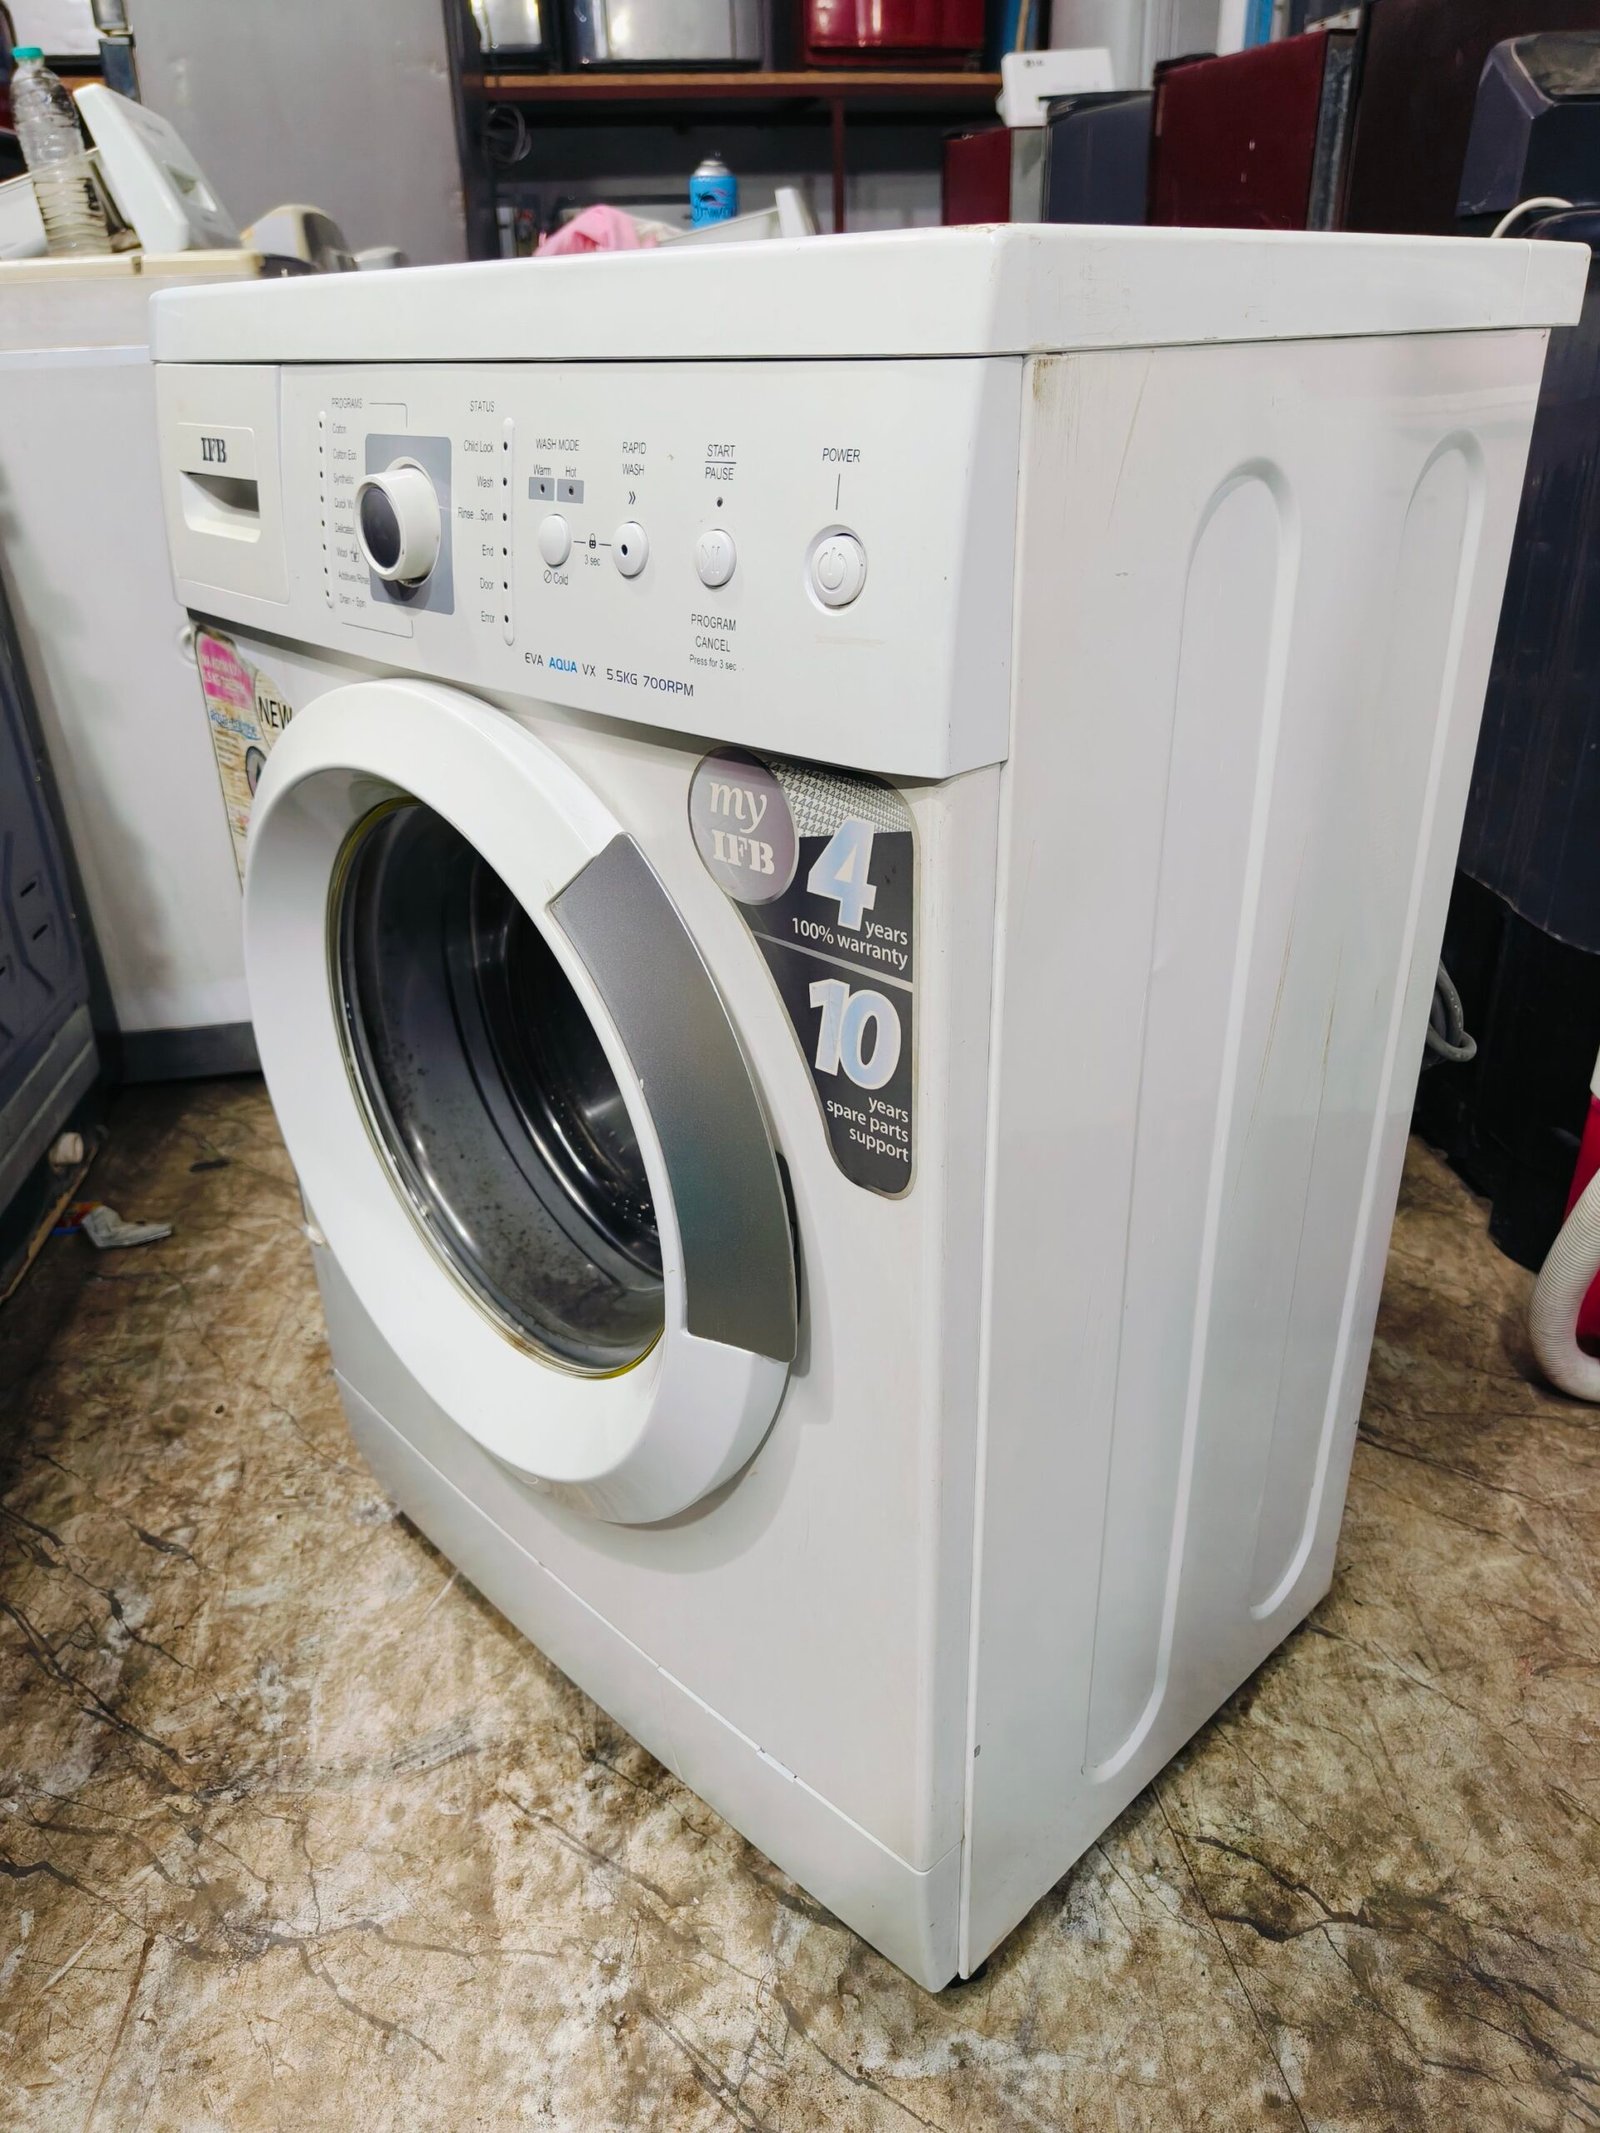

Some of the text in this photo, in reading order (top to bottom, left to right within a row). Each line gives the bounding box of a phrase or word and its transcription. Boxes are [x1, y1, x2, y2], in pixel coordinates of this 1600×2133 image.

[332, 397, 363, 409] PROGRAMS
[470, 400, 495, 413] STATUS
[200, 437, 227, 464] IFB
[463, 439, 494, 453] Child Lock
[536, 438, 580, 452] WASH MODE
[622, 441, 647, 455] RAPID
[706, 443, 736, 457] START
[822, 447, 861, 463] POWER
[533, 463, 577, 478] Warm Hot
[621, 462, 645, 476] WASH
[704, 466, 735, 481] PAUSE
[477, 475, 494, 488] Wash
[457, 506, 474, 519] Rinse
[481, 543, 494, 557] End
[584, 553, 601, 567] 3 sec
[479, 576, 494, 590] Door
[553, 571, 569, 586] Cold
[481, 610, 496, 624] Error
[690, 612, 737, 632] PROGRAM
[695, 635, 731, 653] CANCEL
[689, 653, 737, 672] Press for 3 sec
[524, 651, 695, 698] EVA AQUA VX 5.5KG 700RPM
[258, 695, 293, 731] NEW
[709, 780, 768, 834] my
[711, 828, 776, 875] IFB
[806, 817, 878, 932] 4
[865, 918, 909, 946] years
[792, 917, 909, 971] 100% warranty
[808, 977, 909, 1123] 10 years
[826, 1099, 909, 1143] spare parts
[849, 1126, 909, 1164] support
